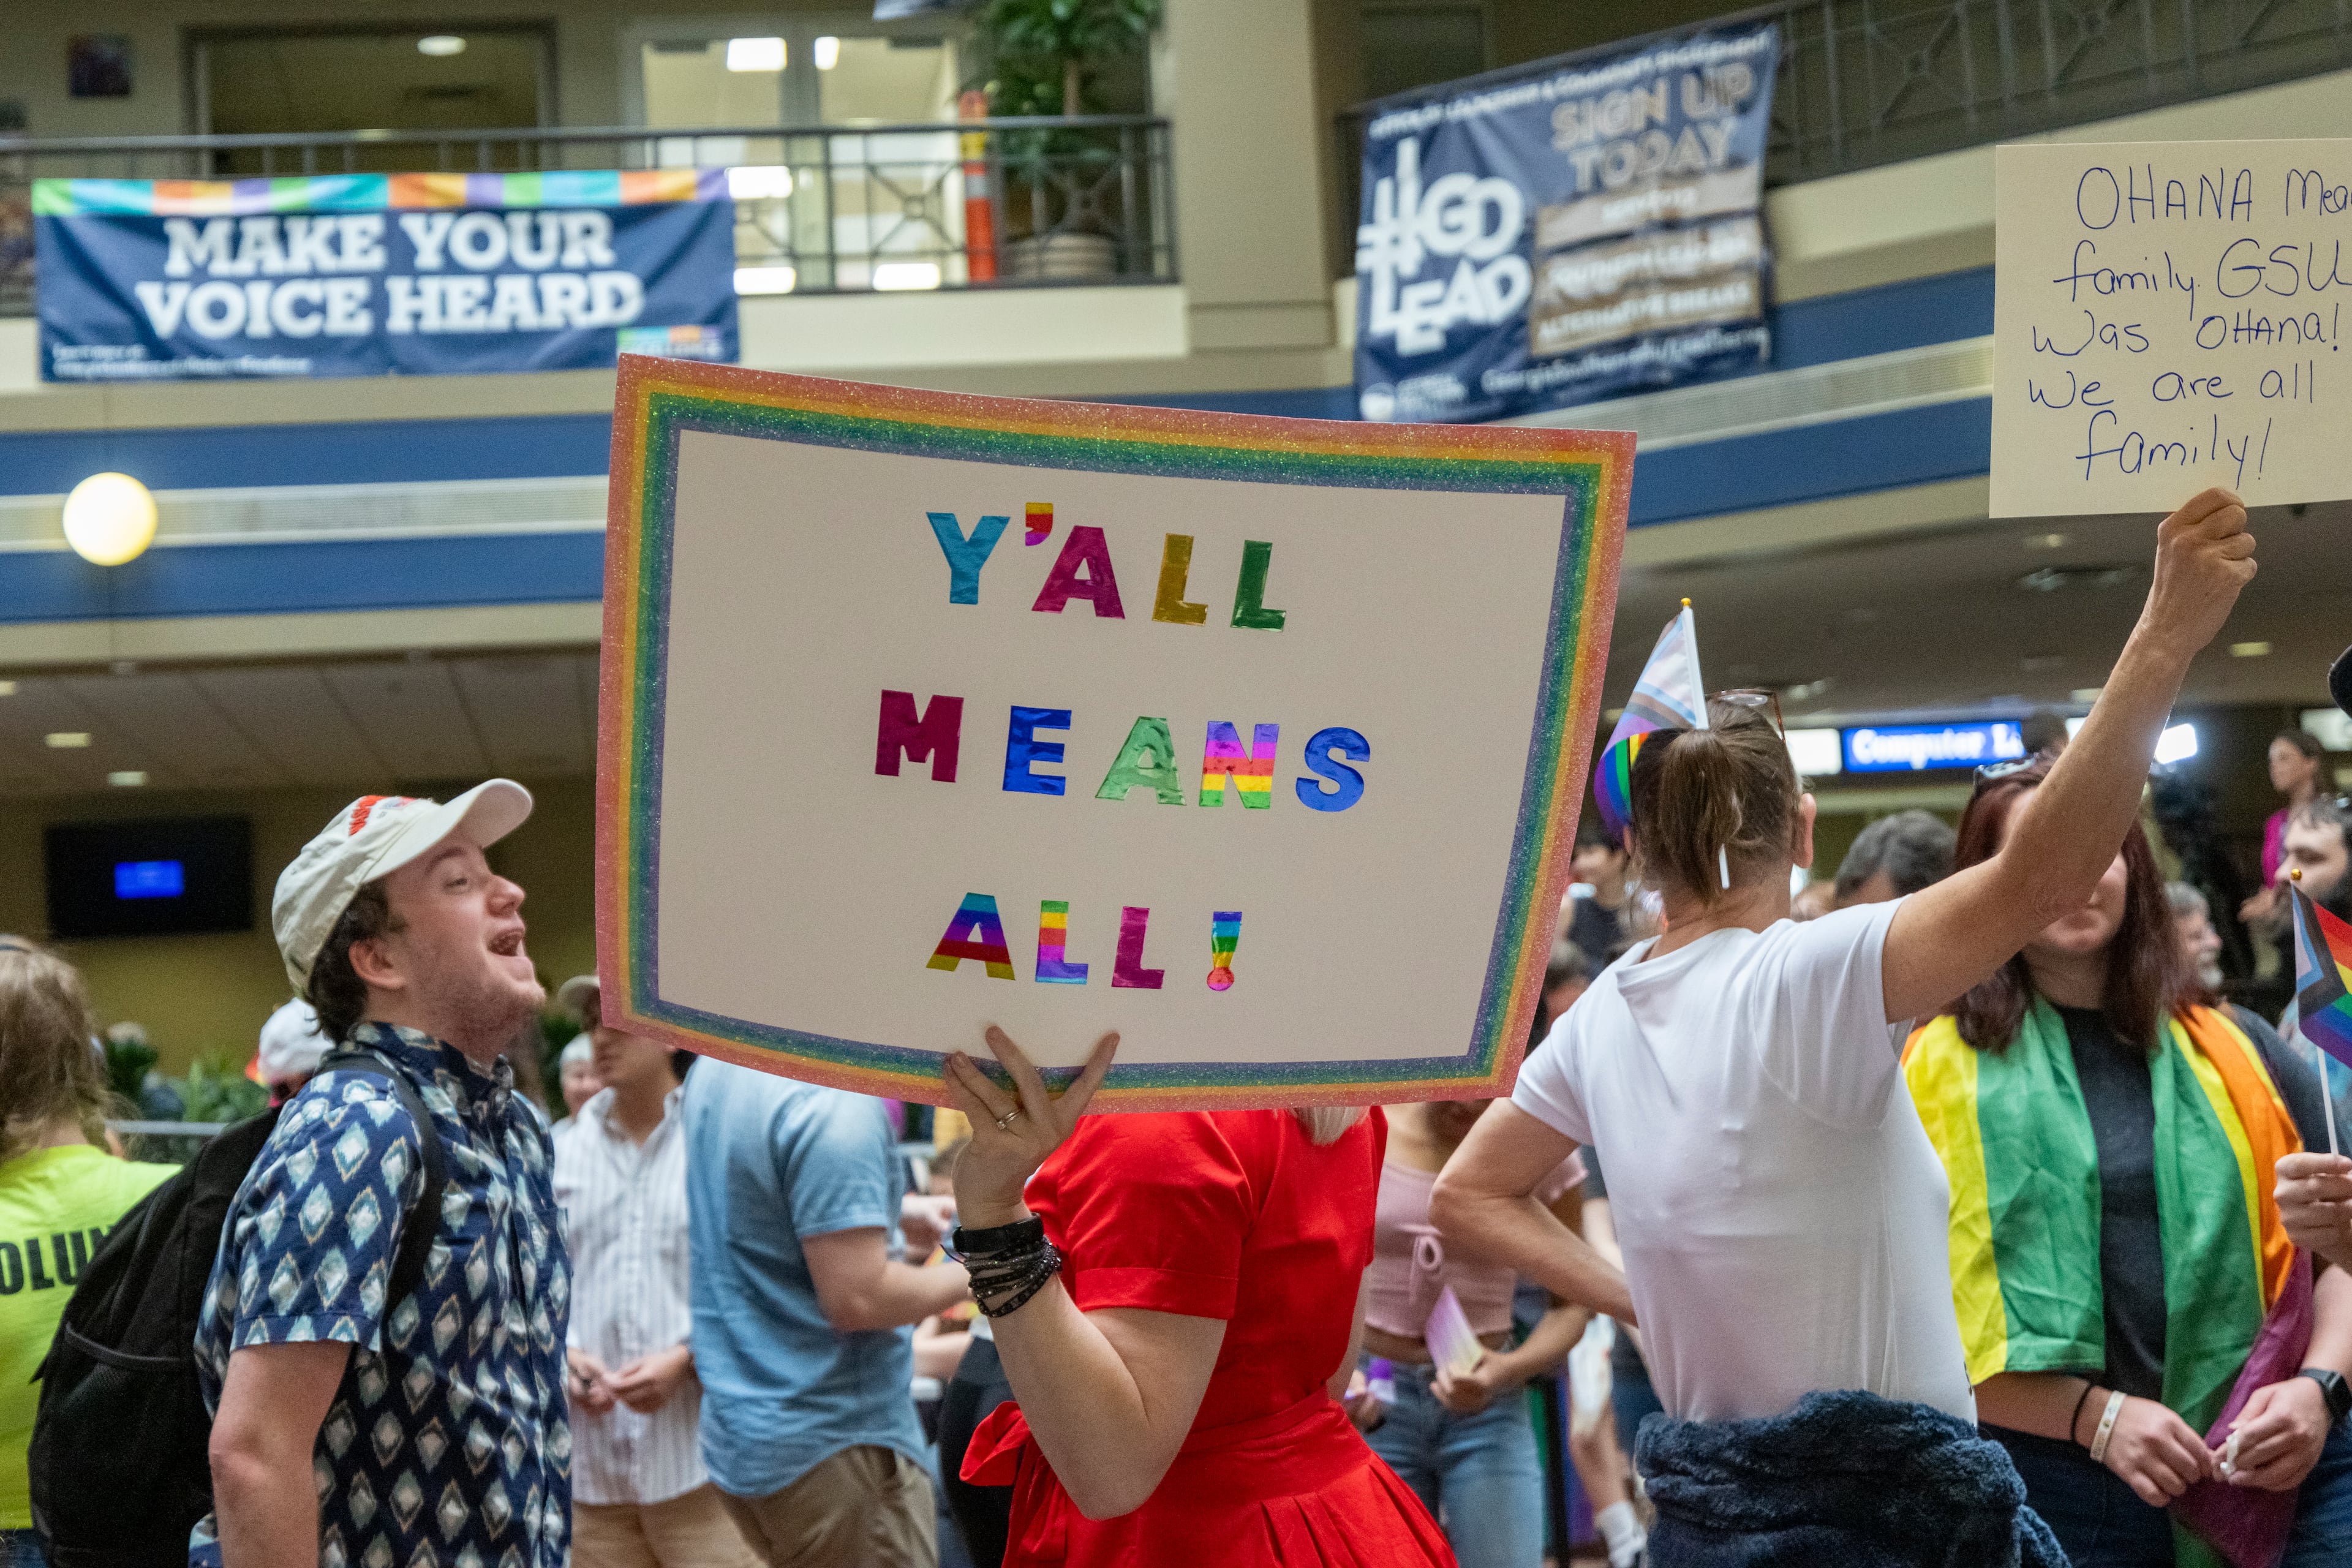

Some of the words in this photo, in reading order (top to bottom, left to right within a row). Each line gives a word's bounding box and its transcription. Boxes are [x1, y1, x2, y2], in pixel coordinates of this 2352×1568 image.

[1551, 78, 1668, 152] SIGN
[1681, 62, 1753, 121] UP
[1570, 116, 1739, 192] TODAY
[2077, 164, 2253, 229] OHANA
[2286, 168, 2352, 216] Mea
[163, 211, 388, 277] MAKE
[399, 209, 614, 271] YOUR
[2217, 238, 2352, 298] GSU
[134, 275, 373, 340] VOICE
[385, 271, 646, 335] HEARD
[1370, 254, 1530, 357] LEAD
[2029, 371, 2114, 409] We
[2153, 372, 2233, 401] are
[2260, 360, 2313, 404] all
[2076, 410, 2272, 490] family!
[925, 502, 1287, 632] Y'ALL
[875, 688, 1371, 813] MEANS
[1852, 728, 1986, 770] Computer
